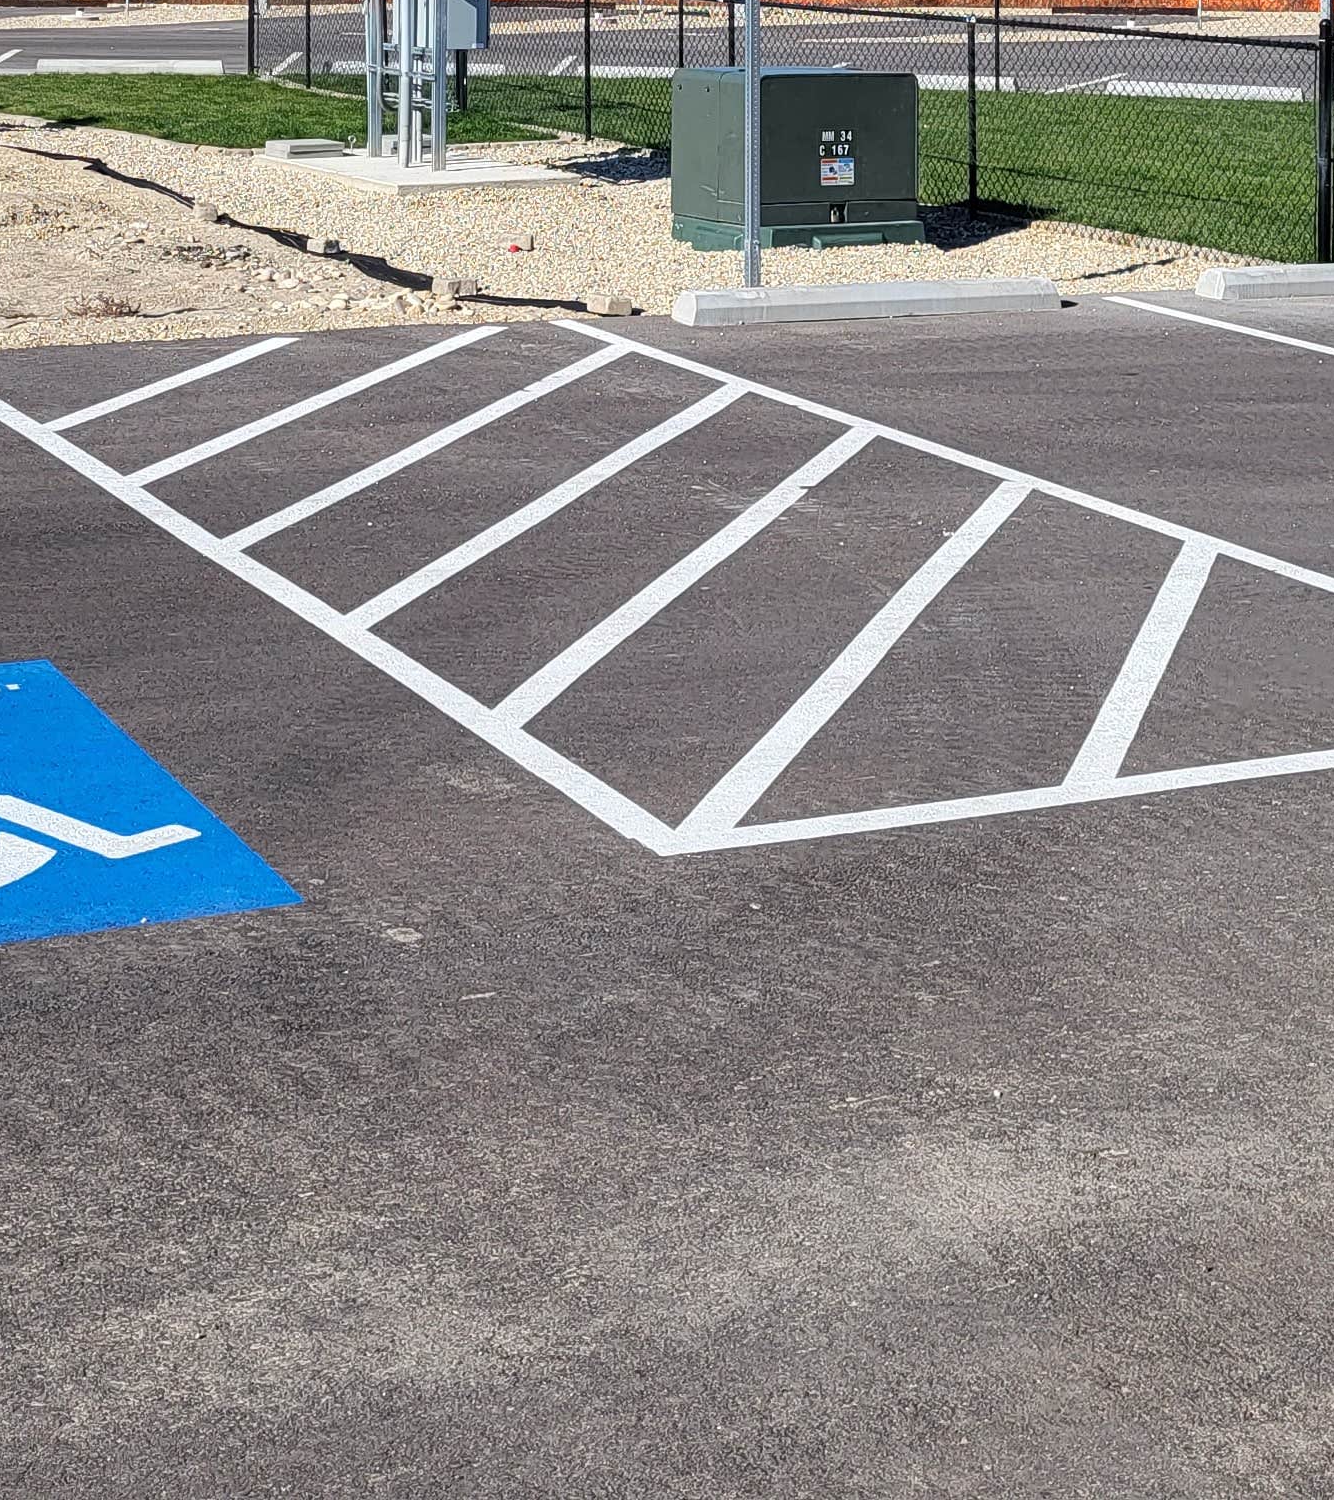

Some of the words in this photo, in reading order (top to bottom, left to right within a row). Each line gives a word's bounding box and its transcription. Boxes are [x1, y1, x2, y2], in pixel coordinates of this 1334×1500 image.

[840, 130, 853, 142] 34
[819, 144, 826, 156] C
[831, 144, 850, 156] 167
